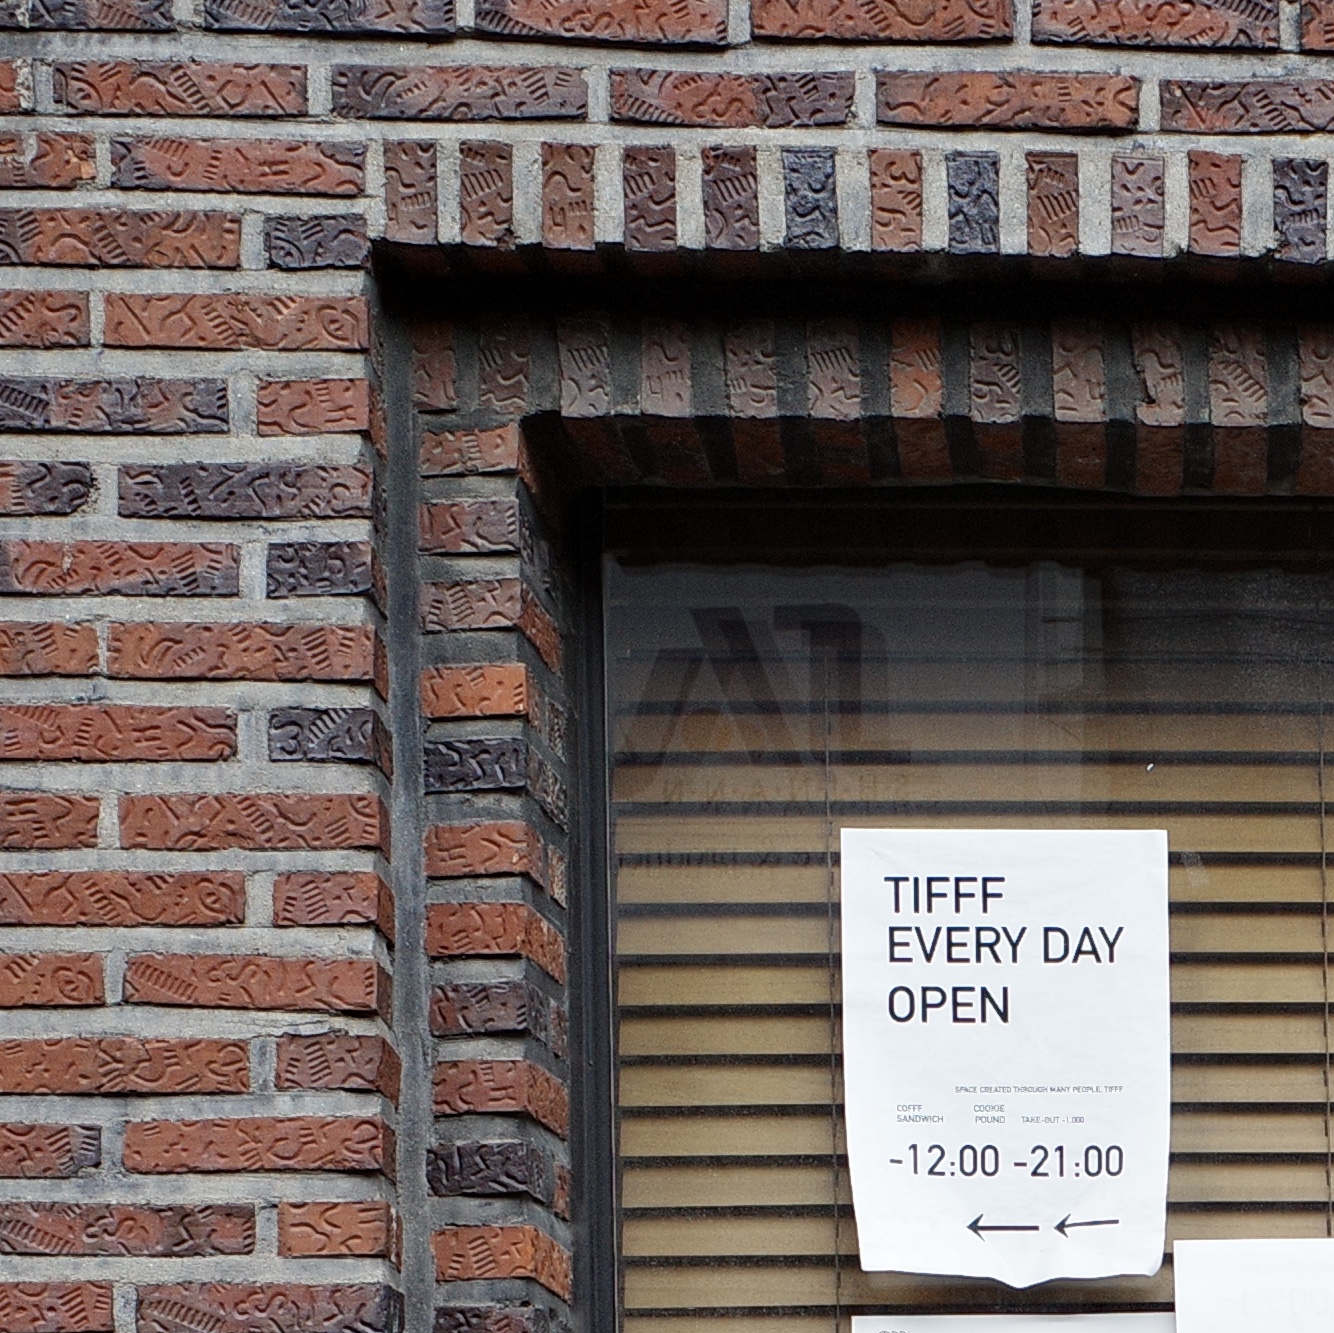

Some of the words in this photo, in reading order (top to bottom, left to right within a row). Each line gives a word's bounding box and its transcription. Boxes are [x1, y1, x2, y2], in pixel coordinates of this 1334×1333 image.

[889, 926, 1027, 963] EVERY
[1043, 927, 1124, 963] DAY
[889, 986, 1008, 1023] OPEN
[896, 1114, 944, 1123] SANDWICH
[890, 1144, 999, 1176] -12:00
[1014, 1145, 1123, 1177] -21:00
